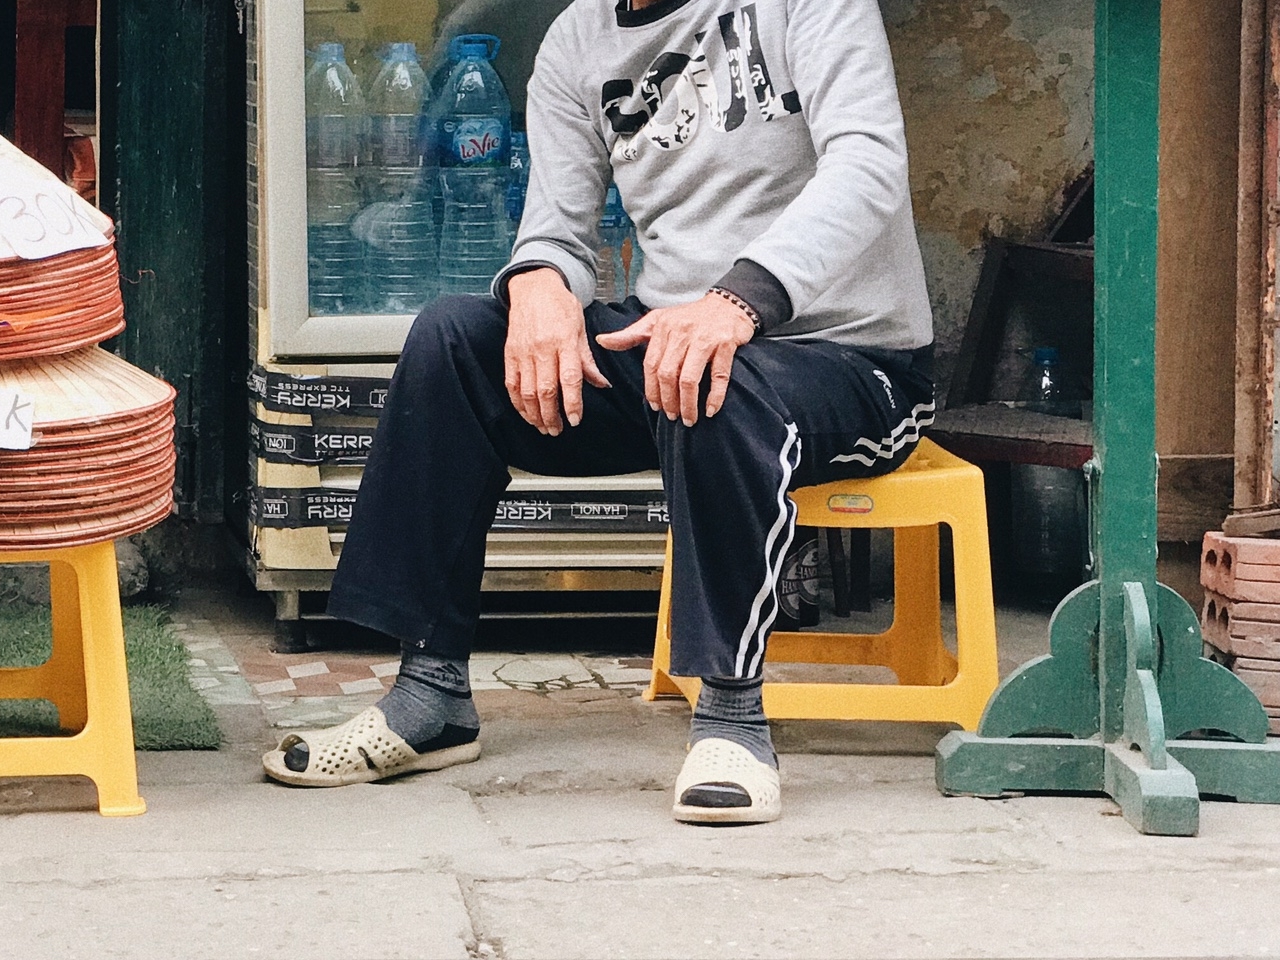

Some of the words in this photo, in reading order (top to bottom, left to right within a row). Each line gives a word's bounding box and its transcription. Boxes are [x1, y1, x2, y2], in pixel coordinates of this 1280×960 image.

[276, 390, 351, 409] KERRY
[313, 433, 373, 449] KERR
[579, 505, 601, 515] NOI
[602, 505, 620, 515] HA
